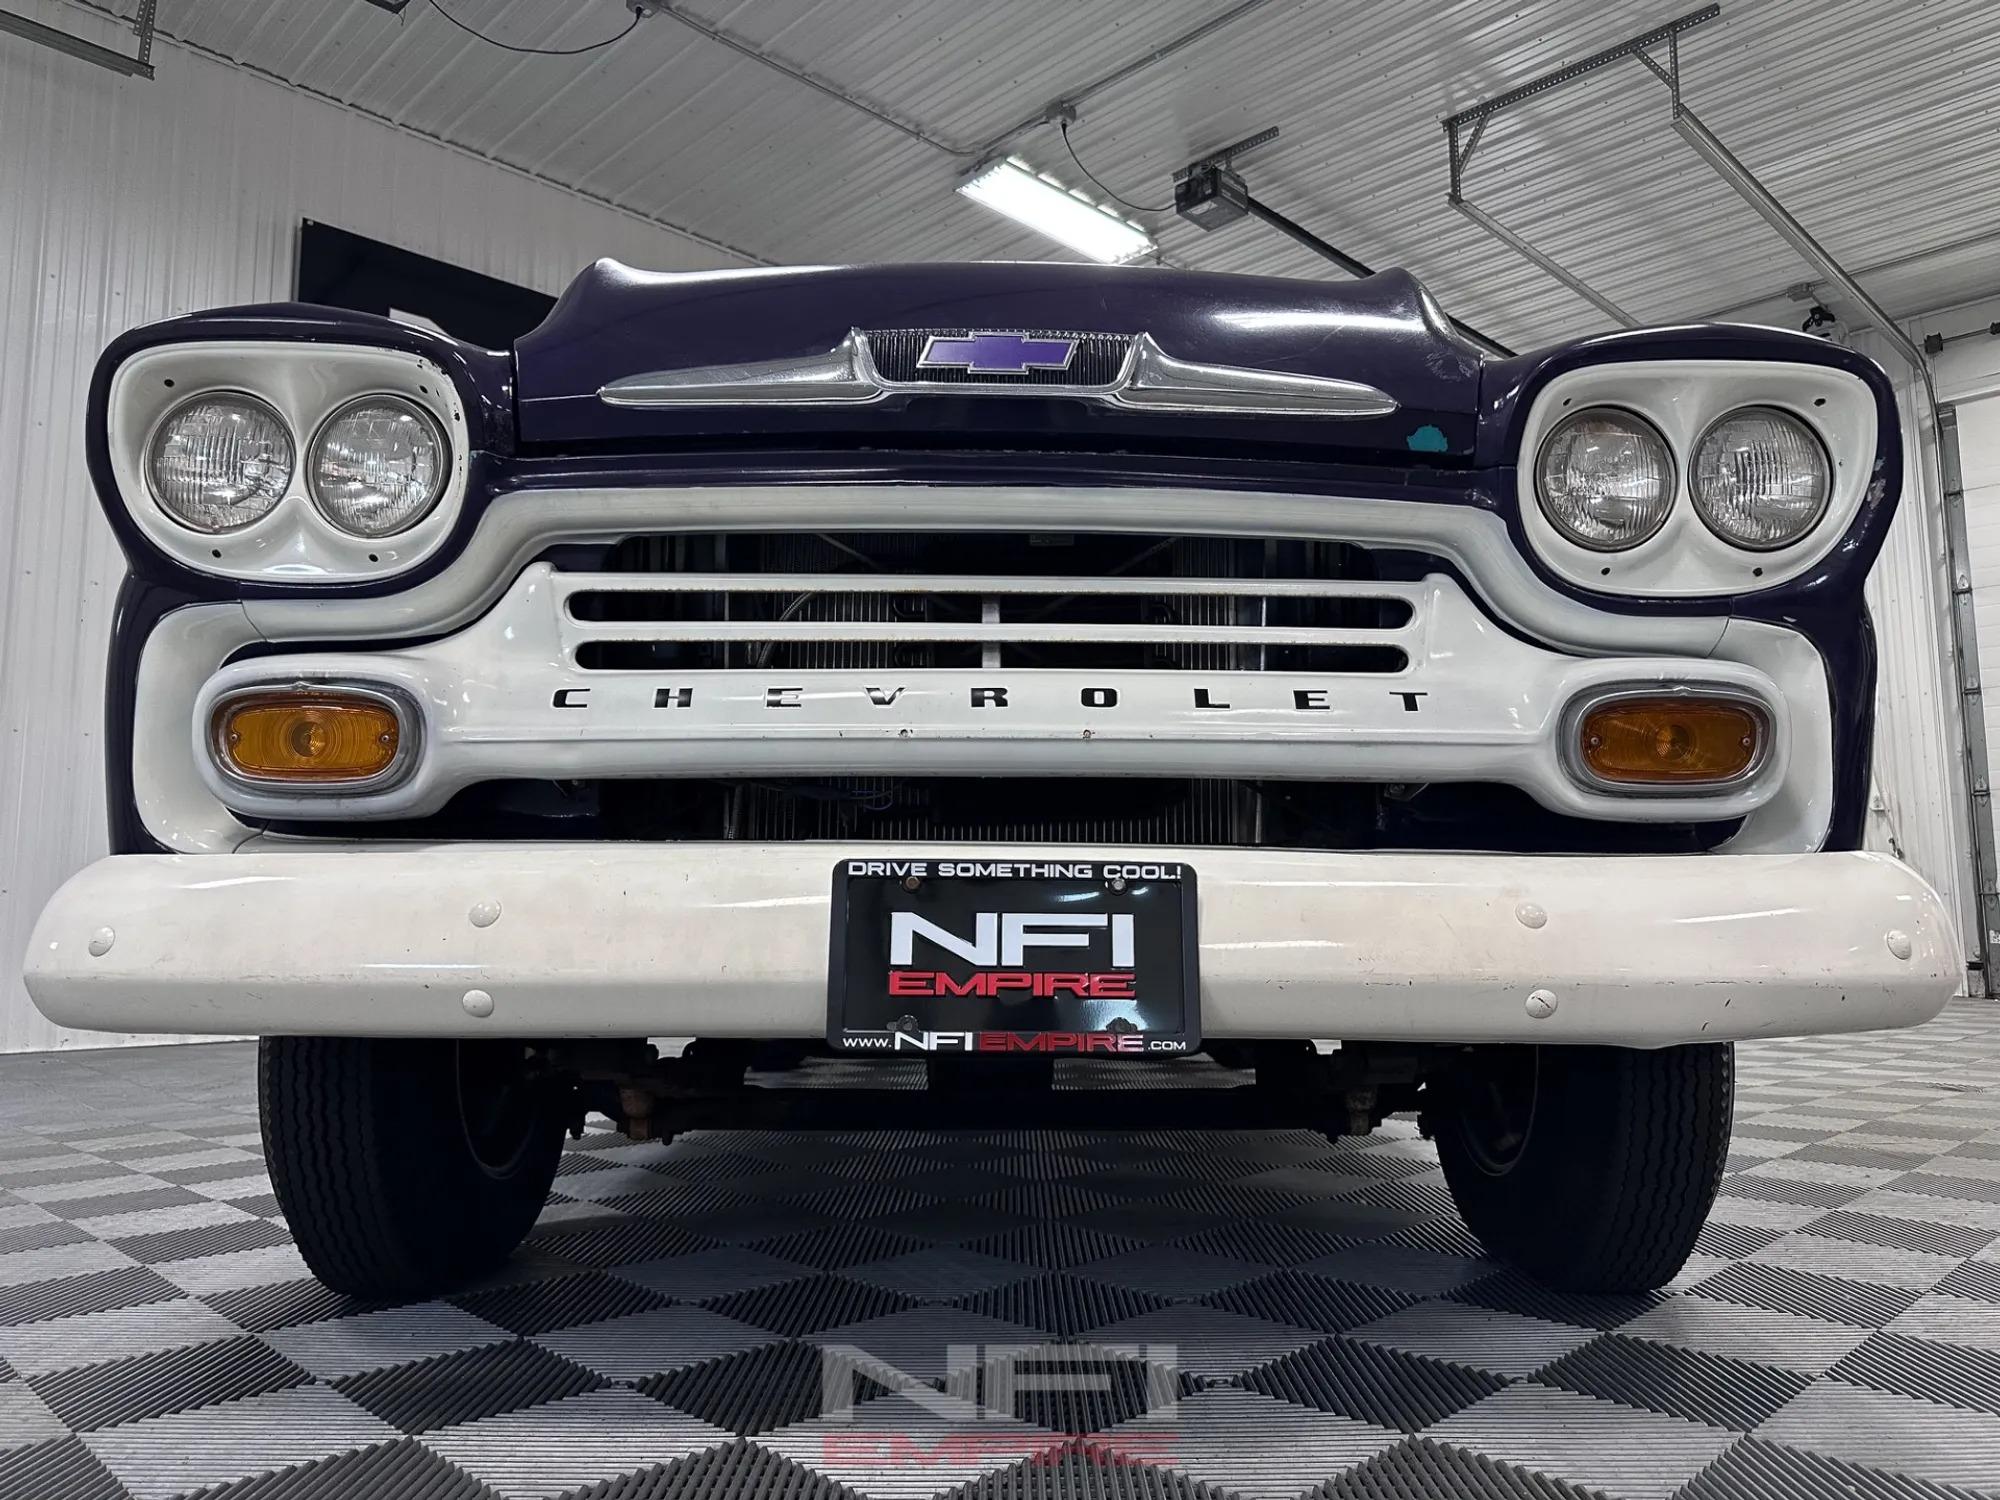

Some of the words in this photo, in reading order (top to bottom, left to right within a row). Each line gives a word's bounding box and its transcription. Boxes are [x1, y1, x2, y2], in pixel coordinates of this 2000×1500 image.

[552, 687, 1428, 712] CHEVROLET
[848, 862, 927, 877] DRIVE
[938, 863, 1093, 879] SOMETHING
[1103, 865, 1182, 880] COOL!
[890, 912, 1135, 967] NFI
[889, 971, 1136, 997] EMPIRE
